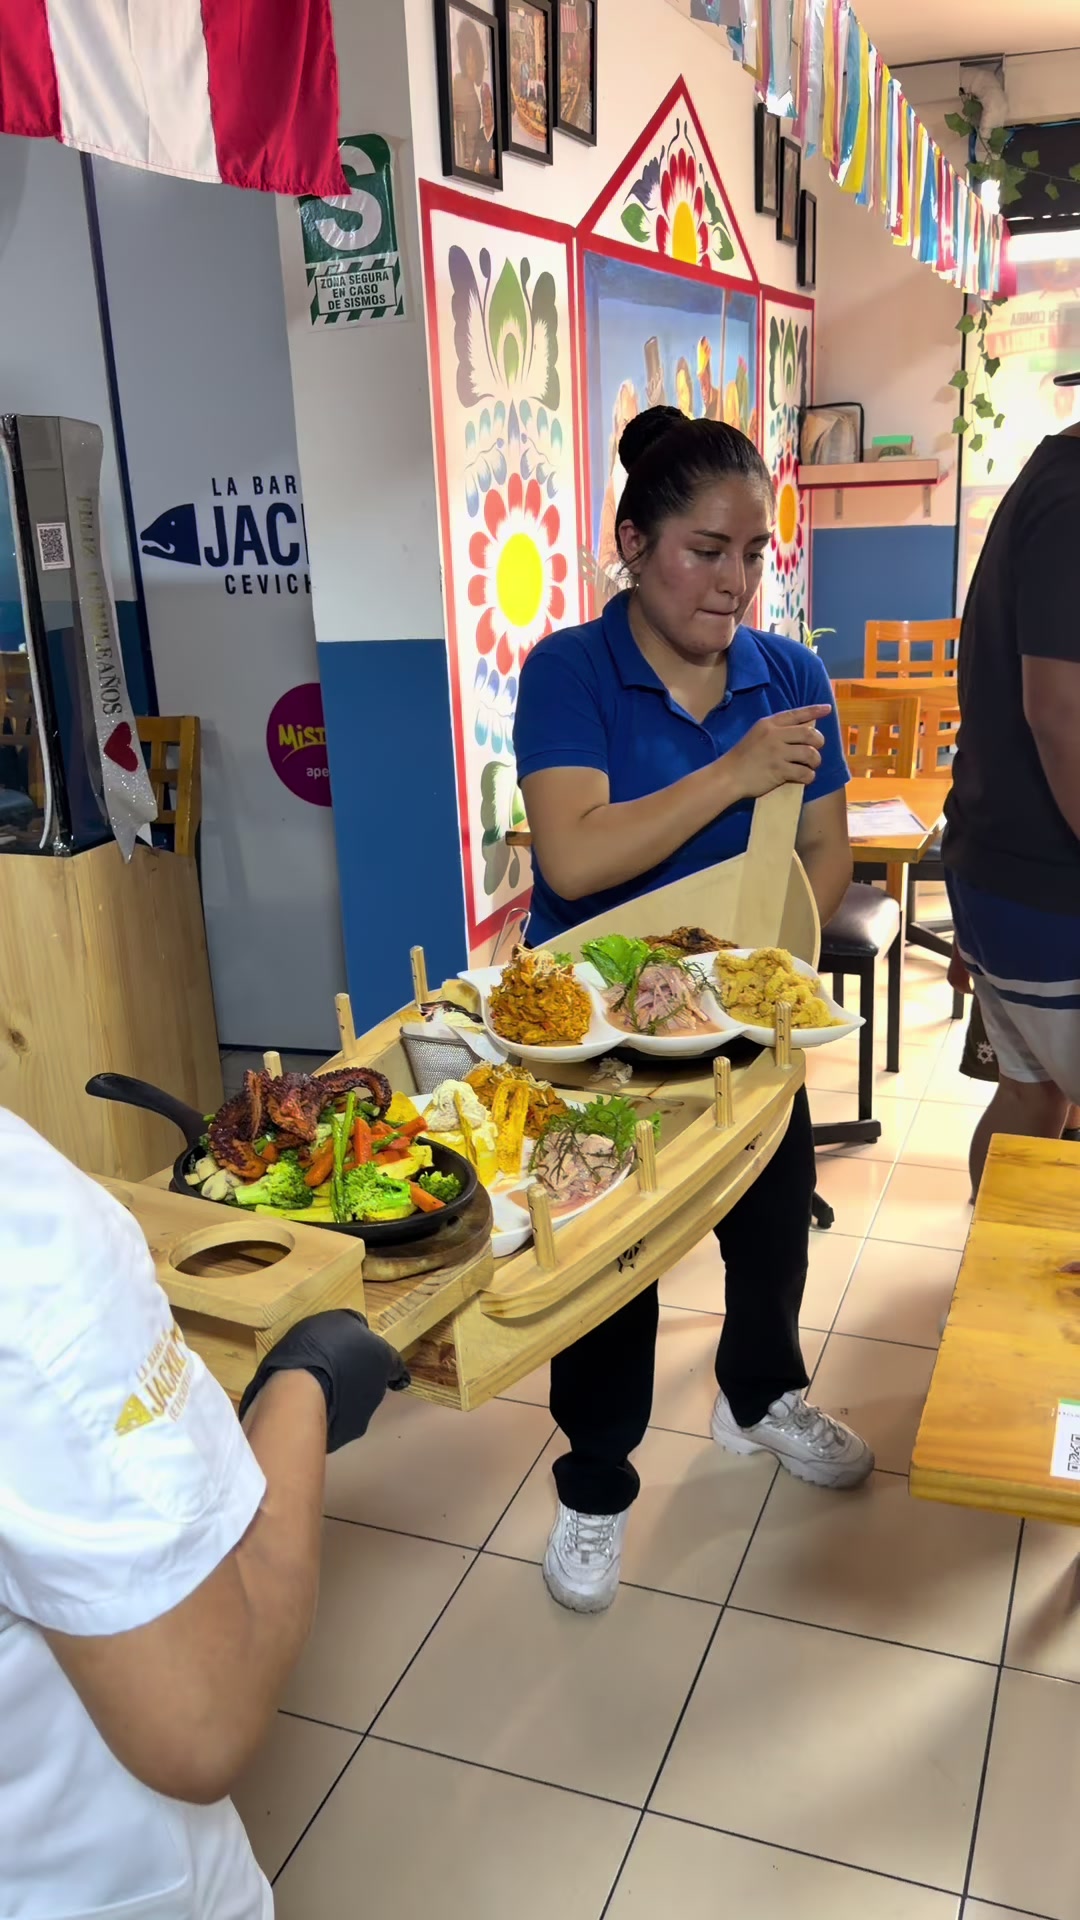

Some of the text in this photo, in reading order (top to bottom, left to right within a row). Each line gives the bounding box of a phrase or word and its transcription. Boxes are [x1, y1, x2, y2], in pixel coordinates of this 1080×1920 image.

[315, 145, 382, 250] S
[320, 270, 389, 289] ZONA SEGURA
[332, 283, 379, 299] EN CASO
[328, 294, 386, 310] DE SISMOS
[212, 475, 297, 496] LA BAR
[204, 502, 309, 567] JAC
